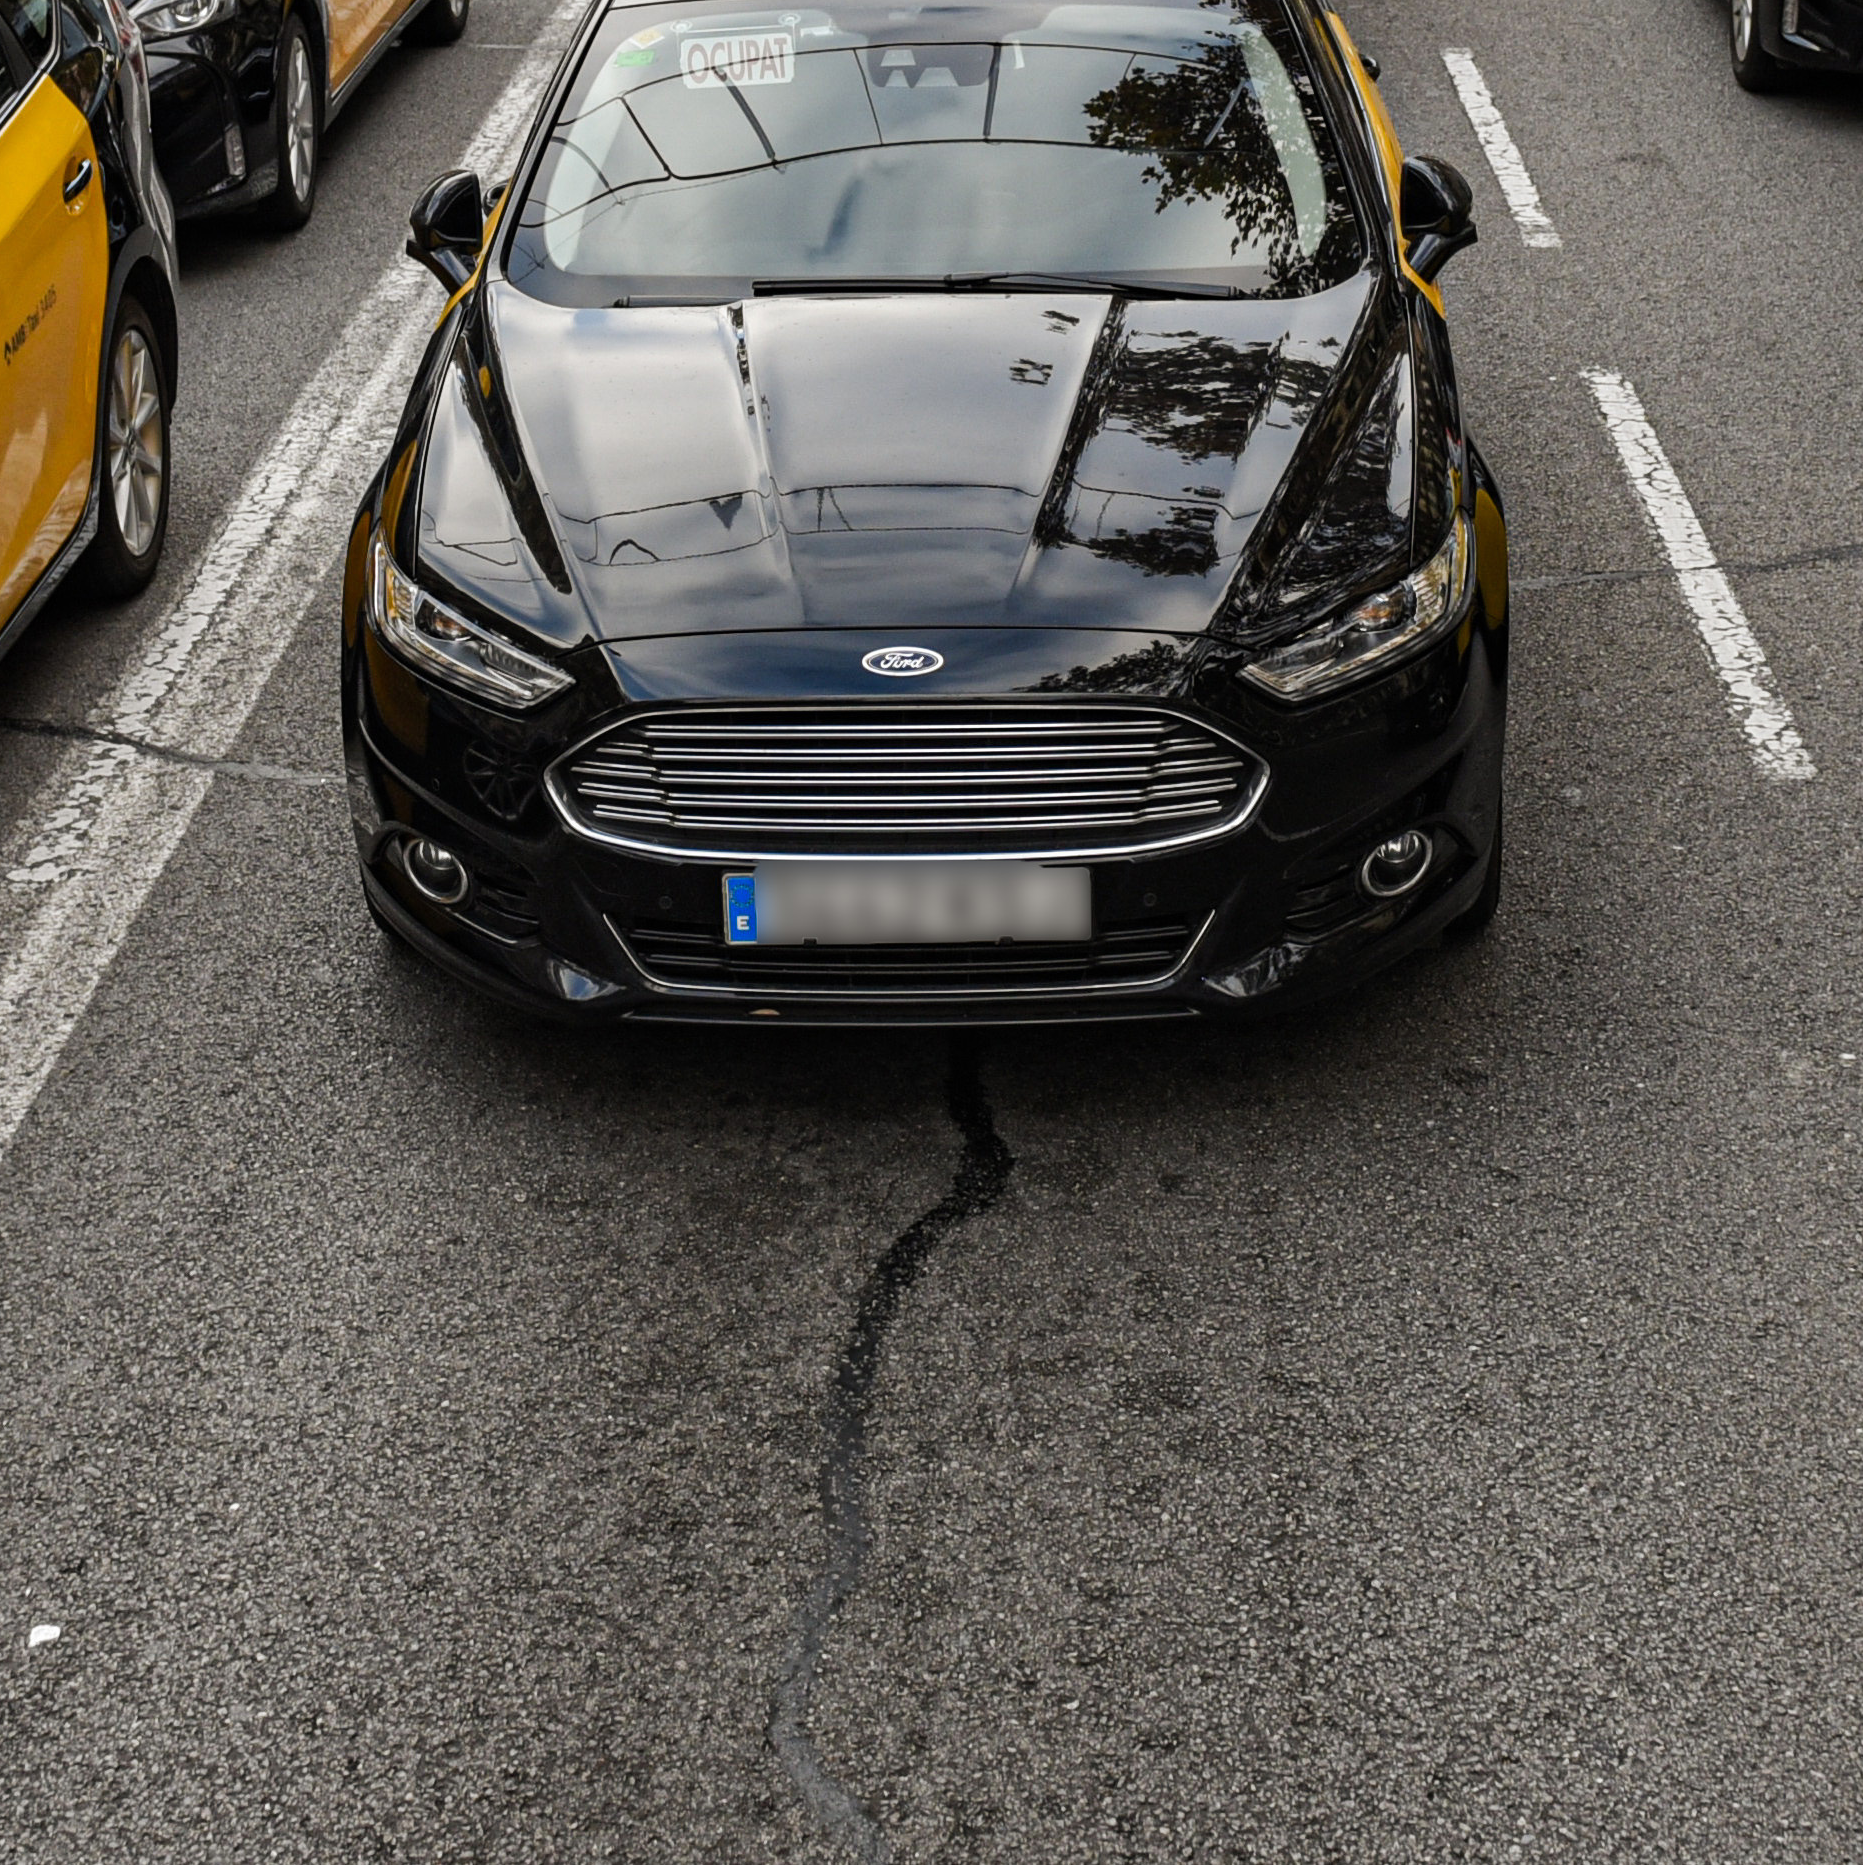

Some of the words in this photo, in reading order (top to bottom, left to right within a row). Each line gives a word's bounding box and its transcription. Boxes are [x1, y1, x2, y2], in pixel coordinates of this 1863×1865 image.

[687, 37, 788, 85] OCUPAT
[880, 652, 926, 670] Ford
[736, 915, 750, 931] E
